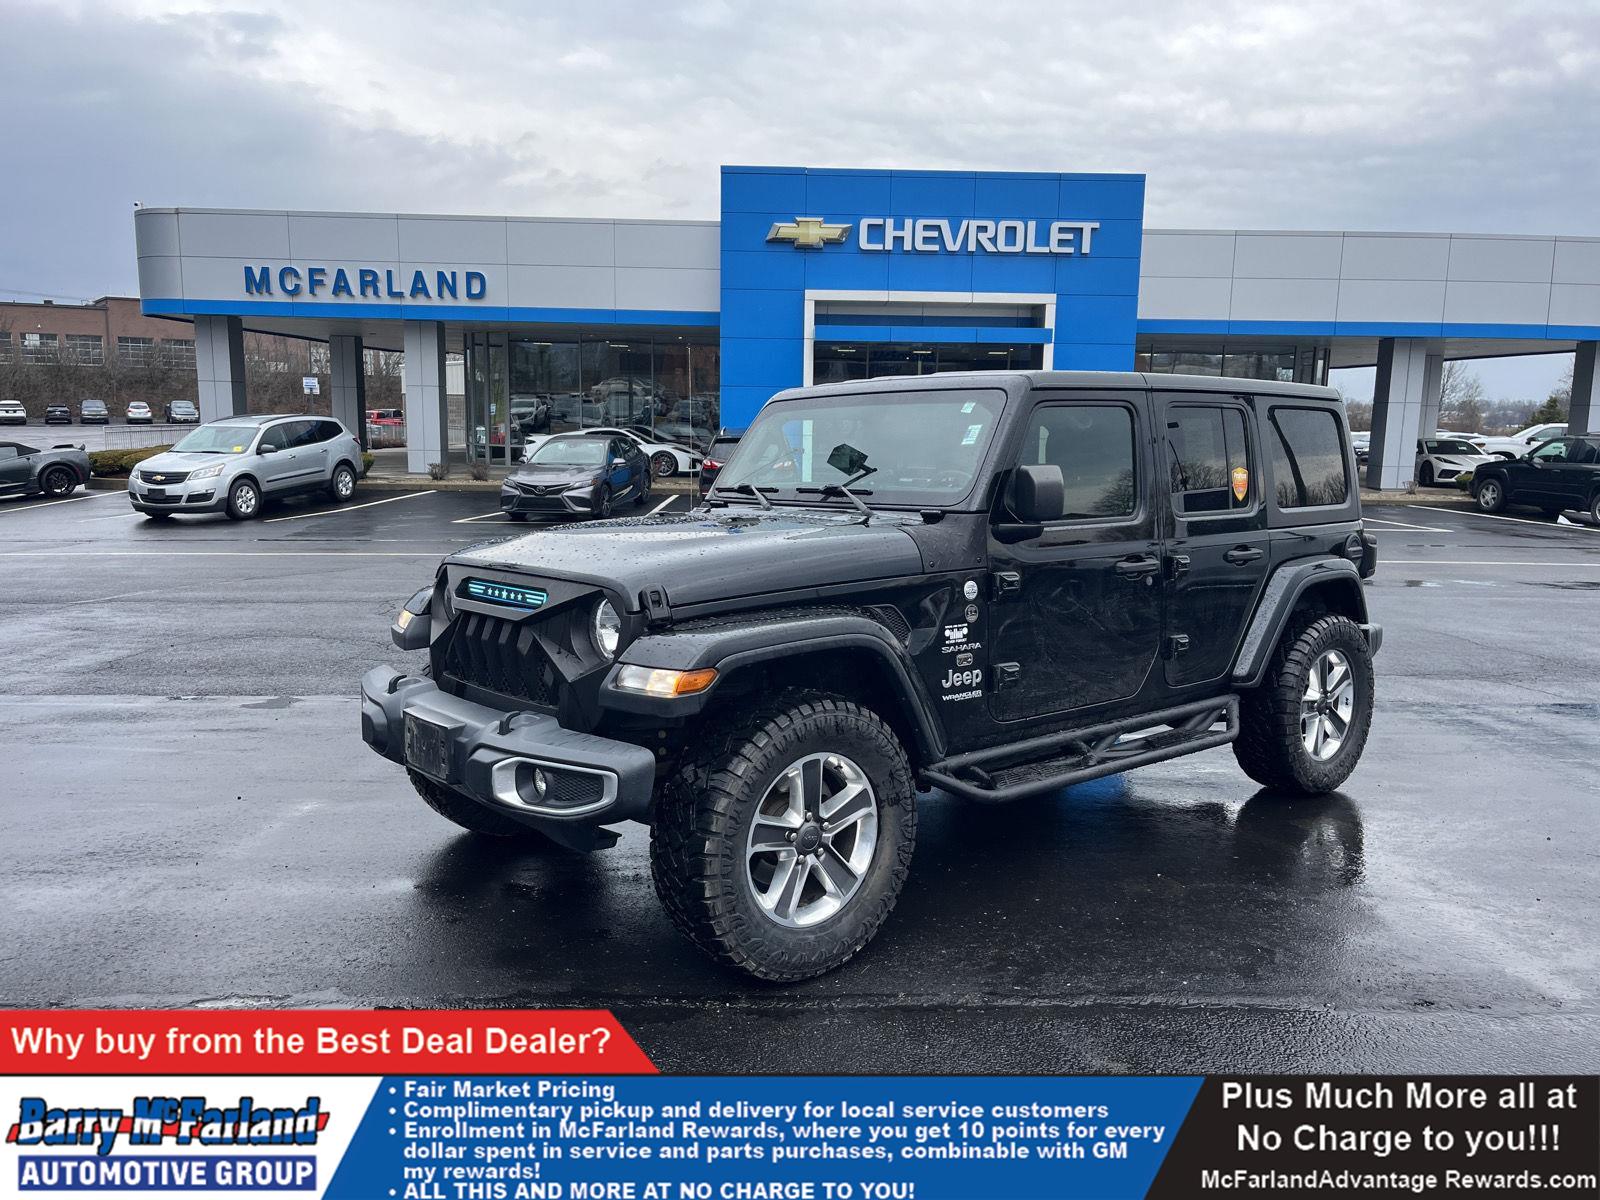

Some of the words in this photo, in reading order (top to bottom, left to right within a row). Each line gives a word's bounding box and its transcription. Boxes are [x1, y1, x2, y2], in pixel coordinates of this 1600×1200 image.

[859, 218, 1100, 254] CHEVROLET
[243, 266, 488, 300] MCFARLAND
[941, 642, 982, 654] SAHARA
[941, 669, 982, 688] Jeep
[942, 690, 982, 701] WRANGLER
